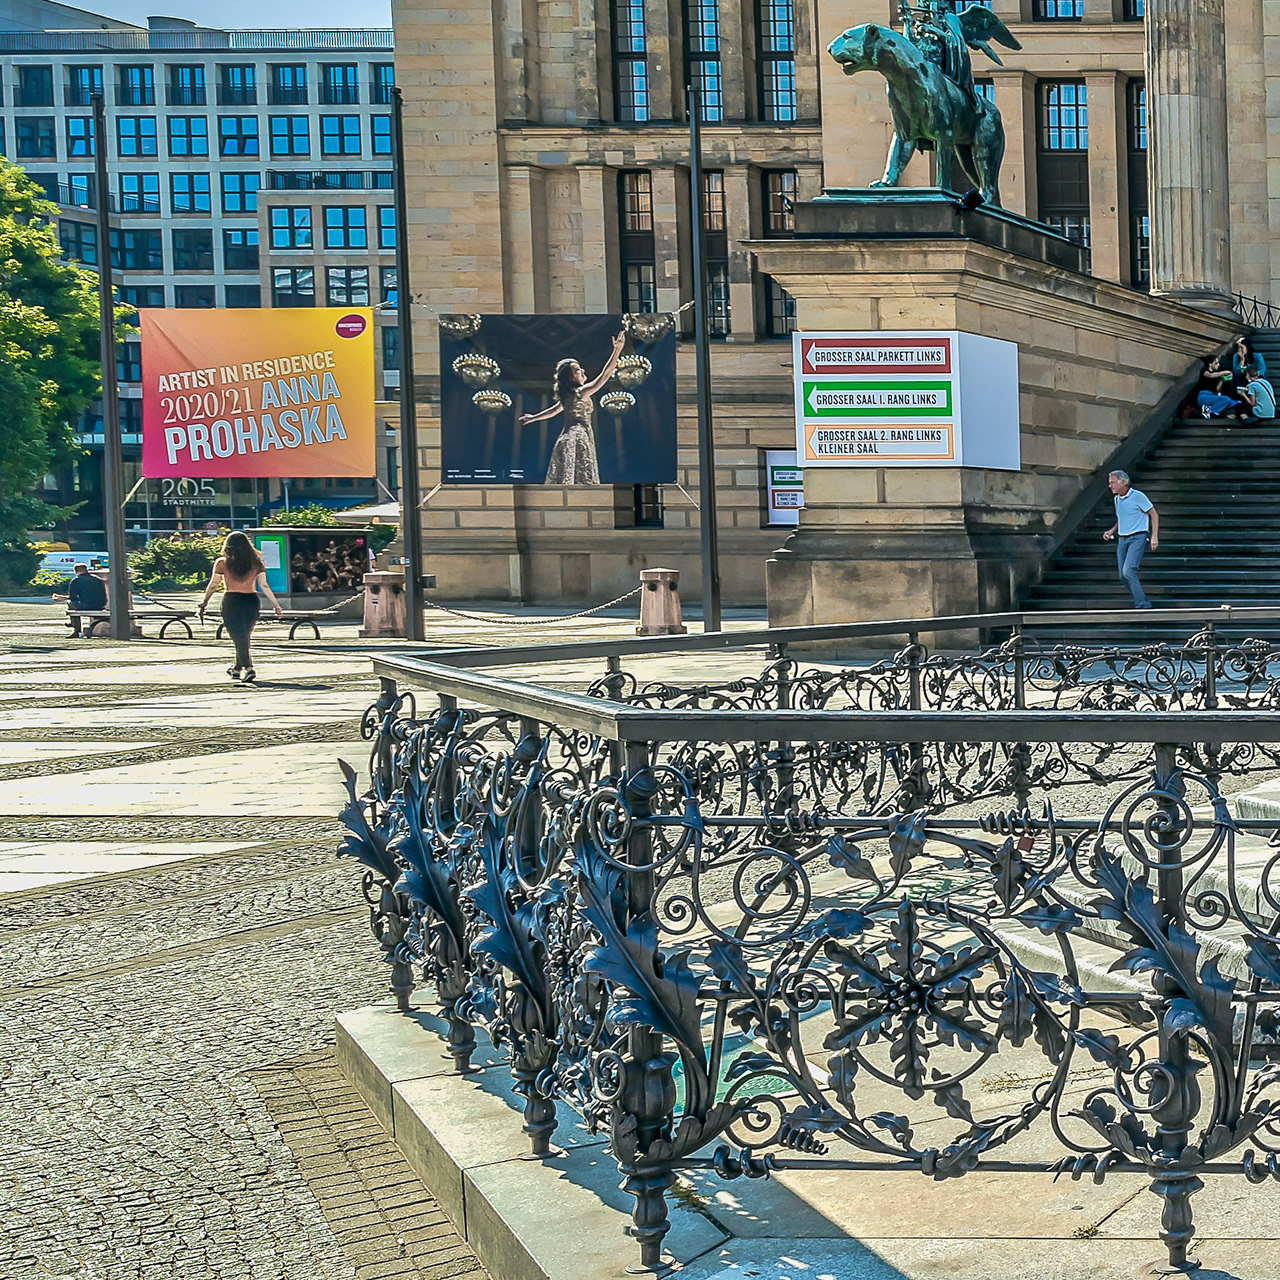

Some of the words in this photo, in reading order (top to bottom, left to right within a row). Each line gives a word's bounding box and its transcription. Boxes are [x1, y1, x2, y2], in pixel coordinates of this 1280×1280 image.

[814, 350, 854, 363] GROSSER
[855, 350, 876, 363] SAAL
[878, 350, 914, 363] PARKETT
[917, 350, 942, 363] LINKS
[158, 368, 216, 393] ARTIST
[220, 365, 240, 385] IN
[241, 350, 336, 381] RESIDENCE
[160, 387, 255, 424] 2020/21
[261, 371, 342, 410] ANNA
[816, 394, 855, 405] GROSSER
[856, 394, 878, 405] SAAL
[887, 394, 910, 405] RANG
[912, 394, 937, 405] LINKS
[164, 403, 348, 465] PROHASKA
[817, 430, 856, 442] GROSSER
[857, 430, 879, 442] SAAL
[880, 430, 889, 442] 2.
[890, 430, 914, 442] RANG
[916, 430, 942, 442] LINKS
[818, 443, 855, 454] KLEINER
[856, 443, 879, 454] SAAL
[161, 478, 216, 496] 205
